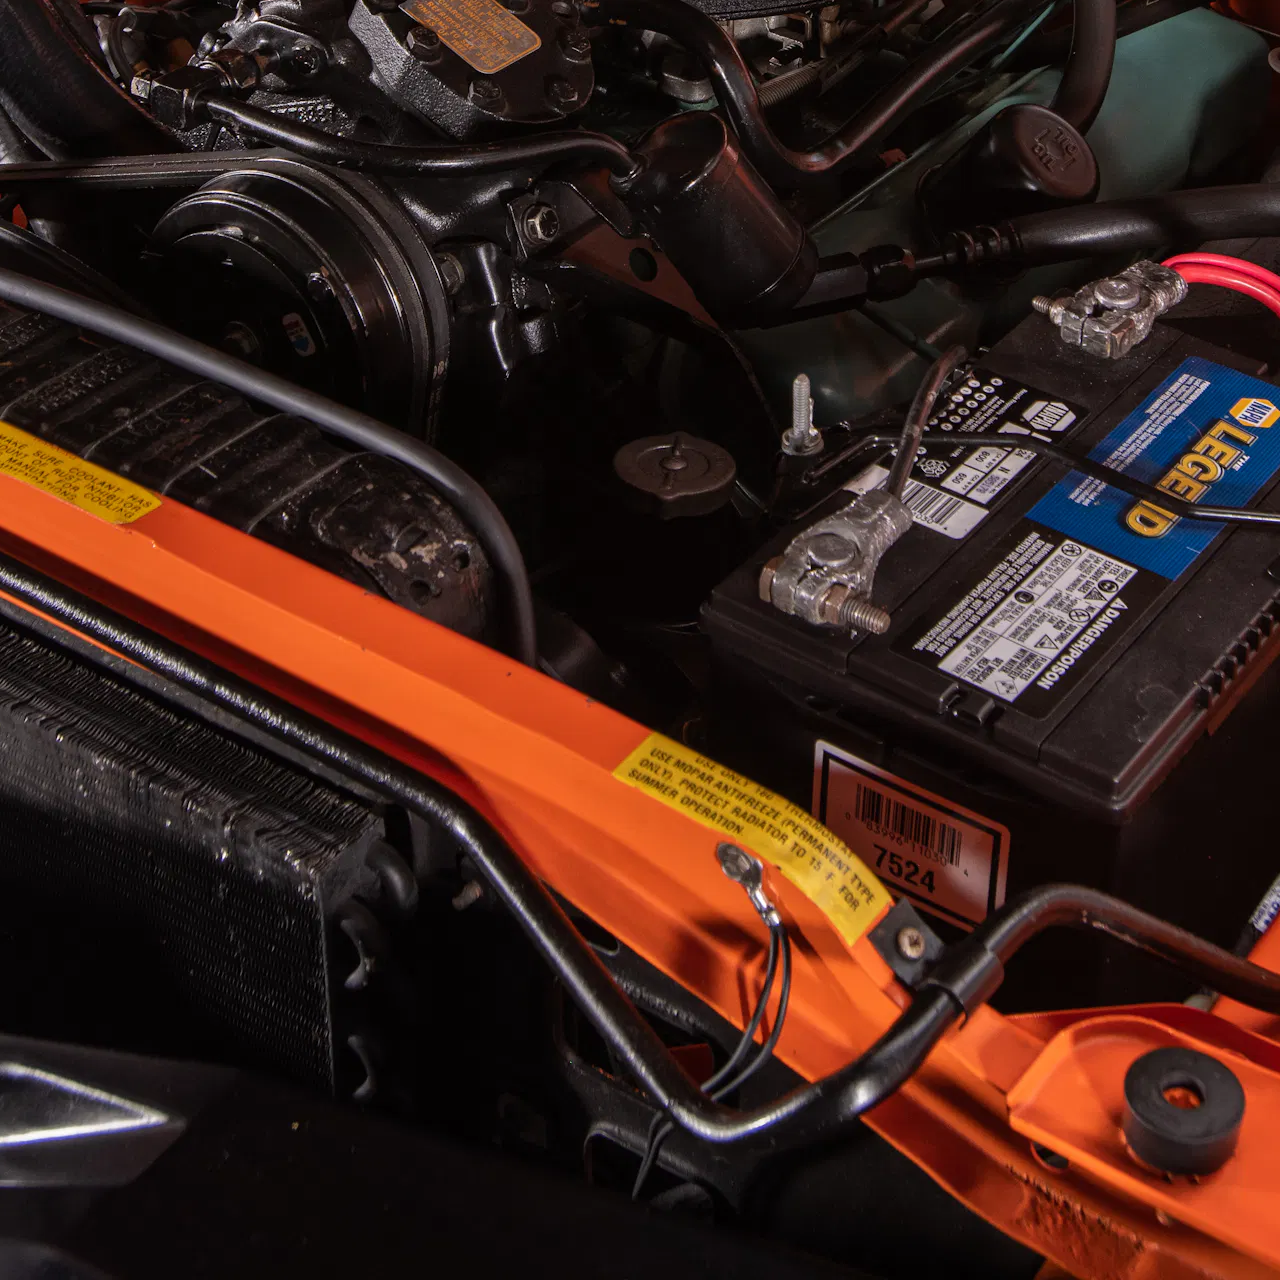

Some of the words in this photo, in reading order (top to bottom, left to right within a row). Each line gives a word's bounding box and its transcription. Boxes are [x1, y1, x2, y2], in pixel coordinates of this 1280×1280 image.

[1029, 403, 1067, 429] NAPA
[1236, 399, 1273, 425] NAPA
[31, 458, 50, 468] OF
[51, 468, 80, 484] RUST
[974, 450, 991, 463] 800
[1230, 454, 1250, 471] THE
[6, 457, 51, 479] MANUAL
[55, 478, 80, 493] FOR
[83, 492, 135, 519] COOLING
[32, 450, 65, 466] SURE
[68, 467, 122, 494] COOLANT
[128, 495, 153, 509] HAS
[950, 472, 967, 484] 650
[985, 560, 1010, 581] FOLLOW
[1036, 604, 1119, 691] DANGER/POISON
[694, 756, 717, 771] USE
[721, 770, 750, 788] ONLY
[628, 769, 678, 799] SUMMER
[679, 796, 745, 837] OPERATION.
[845, 812, 850, 820] 0
[649, 748, 673, 764] USE
[673, 759, 714, 785] MOPAR
[715, 780, 783, 820] ANTIFREEZE
[781, 816, 852, 876] (PERMANENT
[849, 870, 876, 904] TYPE
[678, 778, 729, 810] PROTECT
[731, 805, 790, 845] RADIATOR
[790, 842, 806, 858] TO
[838, 884, 861, 912] FOR
[873, 844, 936, 893] 7524
